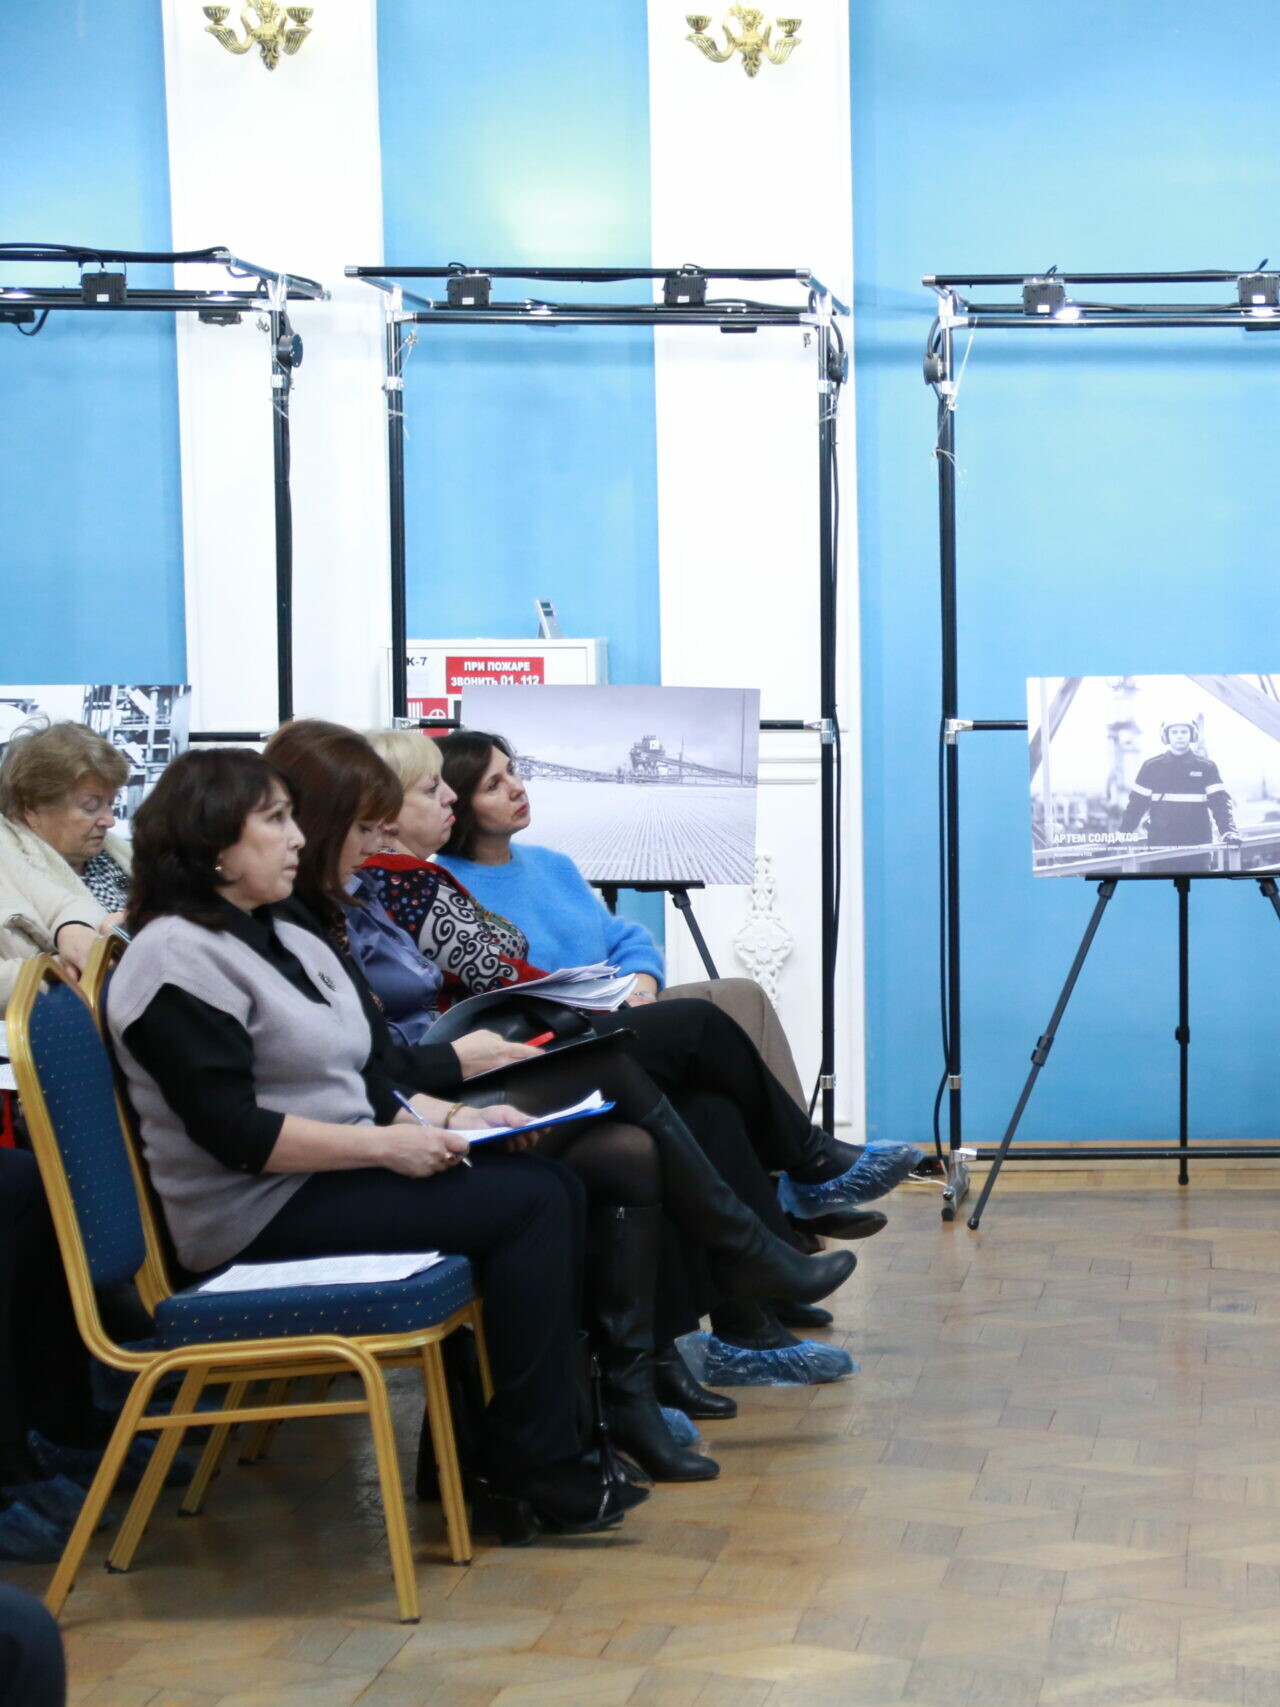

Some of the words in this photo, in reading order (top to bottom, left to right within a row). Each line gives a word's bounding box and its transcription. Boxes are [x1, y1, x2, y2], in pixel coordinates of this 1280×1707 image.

[464, 661, 485, 671] ПРИ
[487, 661, 531, 672] ПОЖАРЕ
[451, 676, 498, 686] ЗВОНИТЬ
[521, 675, 540, 685] 112
[1053, 833, 1086, 844] АРТЕМ
